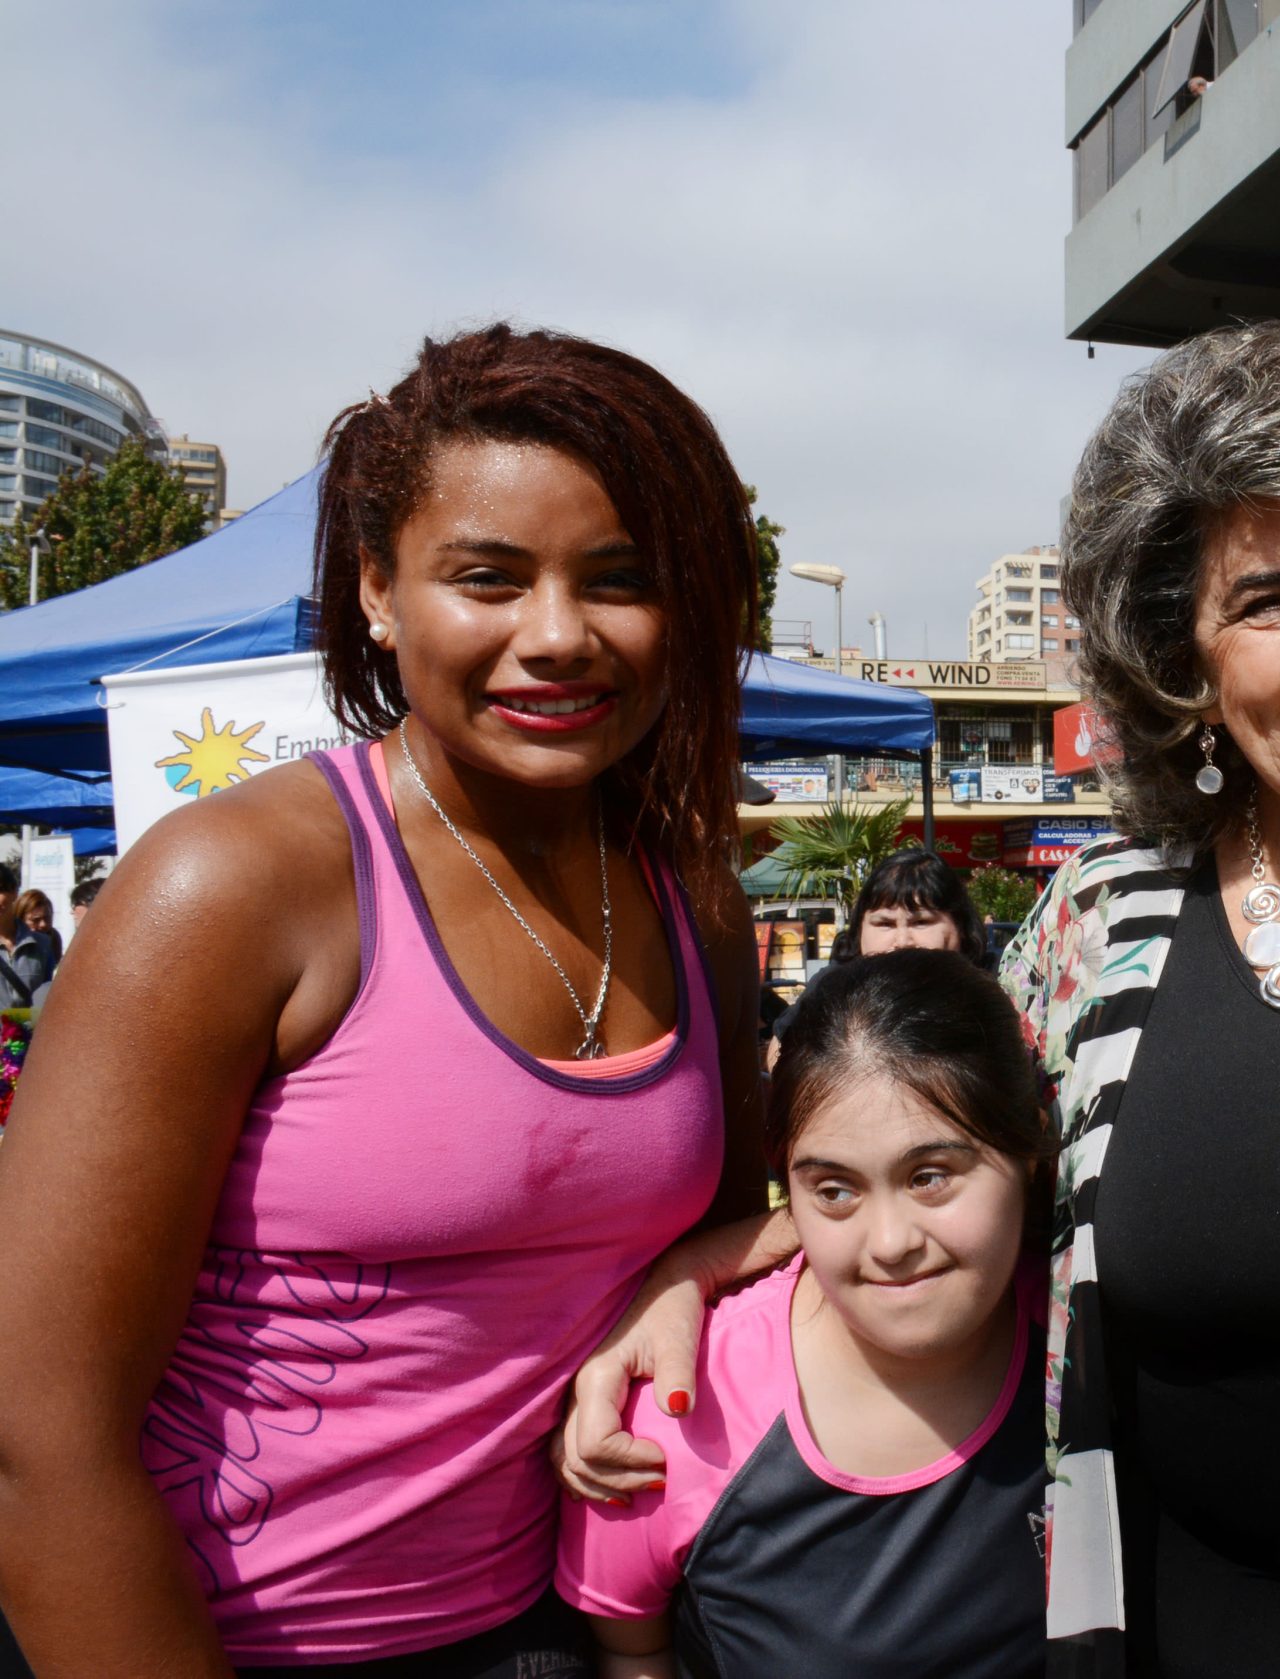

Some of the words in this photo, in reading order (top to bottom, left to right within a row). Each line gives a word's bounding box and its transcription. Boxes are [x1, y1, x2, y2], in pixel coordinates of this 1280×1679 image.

[862, 663, 888, 683] RE
[928, 664, 991, 685] WIND
[1038, 820, 1088, 830] CASIO
[1039, 849, 1071, 861] CASA
